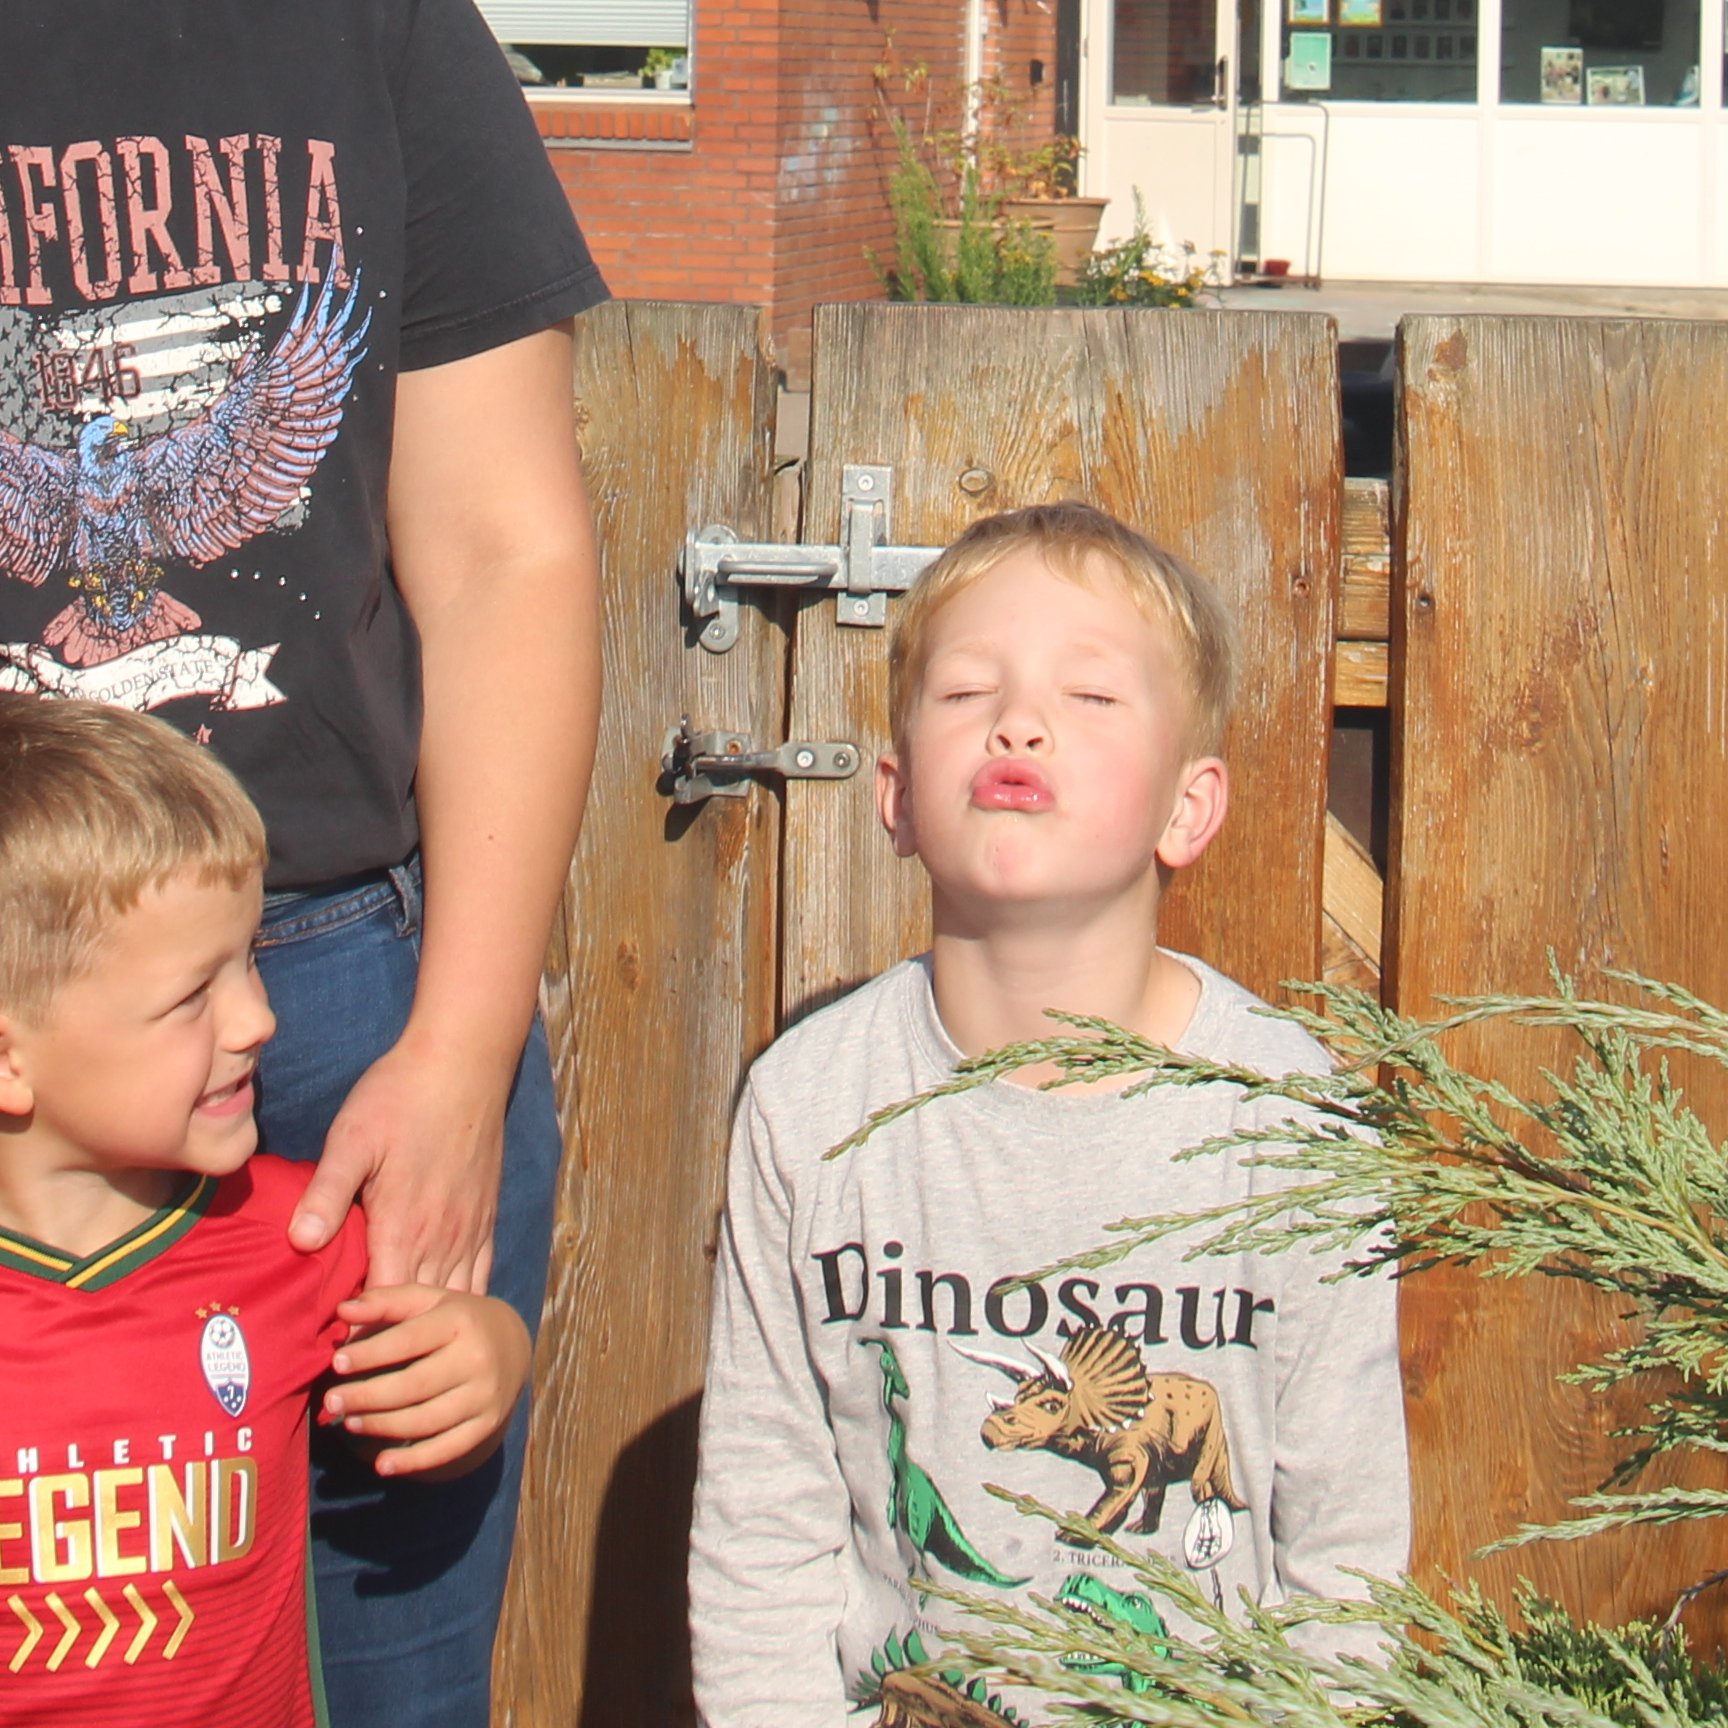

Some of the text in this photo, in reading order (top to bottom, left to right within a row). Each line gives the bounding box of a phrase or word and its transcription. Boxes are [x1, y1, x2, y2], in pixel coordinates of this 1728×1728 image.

[89, 671, 160, 705] GOLDEN
[159, 659, 215, 679] STATE
[813, 1240, 1275, 1350] Dinosaur
[207, 1351, 244, 1362] ATHLETIC
[208, 1362, 246, 1373] LEGEND
